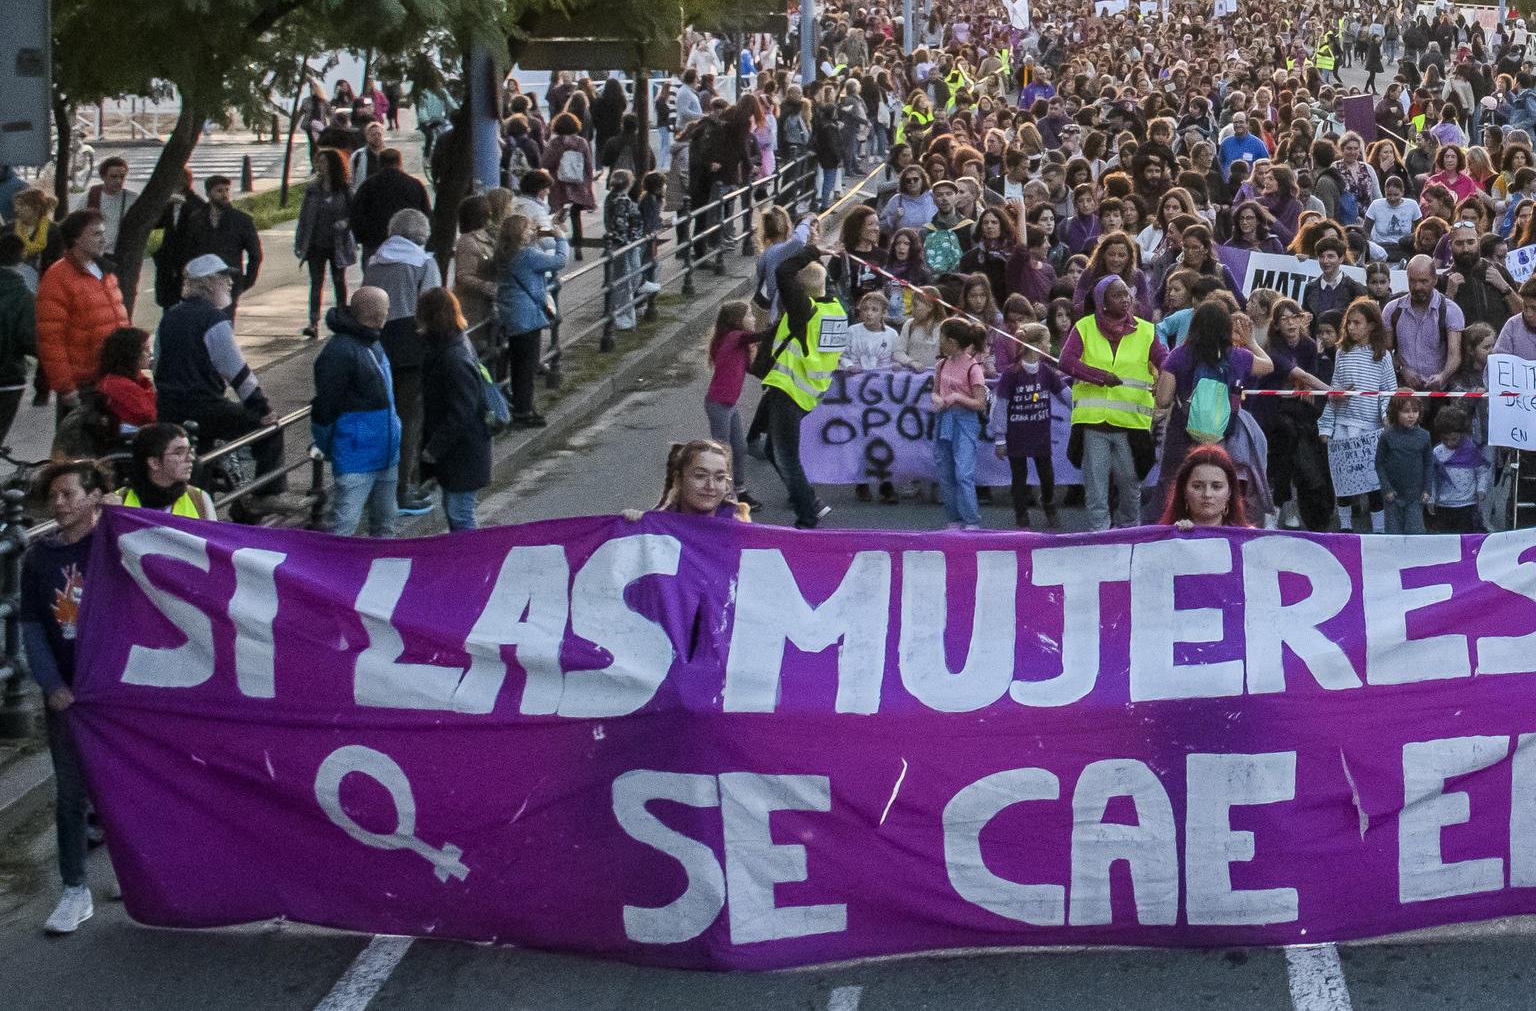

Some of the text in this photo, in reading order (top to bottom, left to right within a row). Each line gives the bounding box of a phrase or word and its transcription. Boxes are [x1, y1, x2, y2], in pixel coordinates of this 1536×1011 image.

[1497, 361, 1520, 389] EL
[1511, 427, 1528, 442] EN
[118, 526, 286, 698] SI
[353, 533, 682, 718] LAS
[611, 769, 847, 945] SE
[942, 750, 1299, 926] CAE
